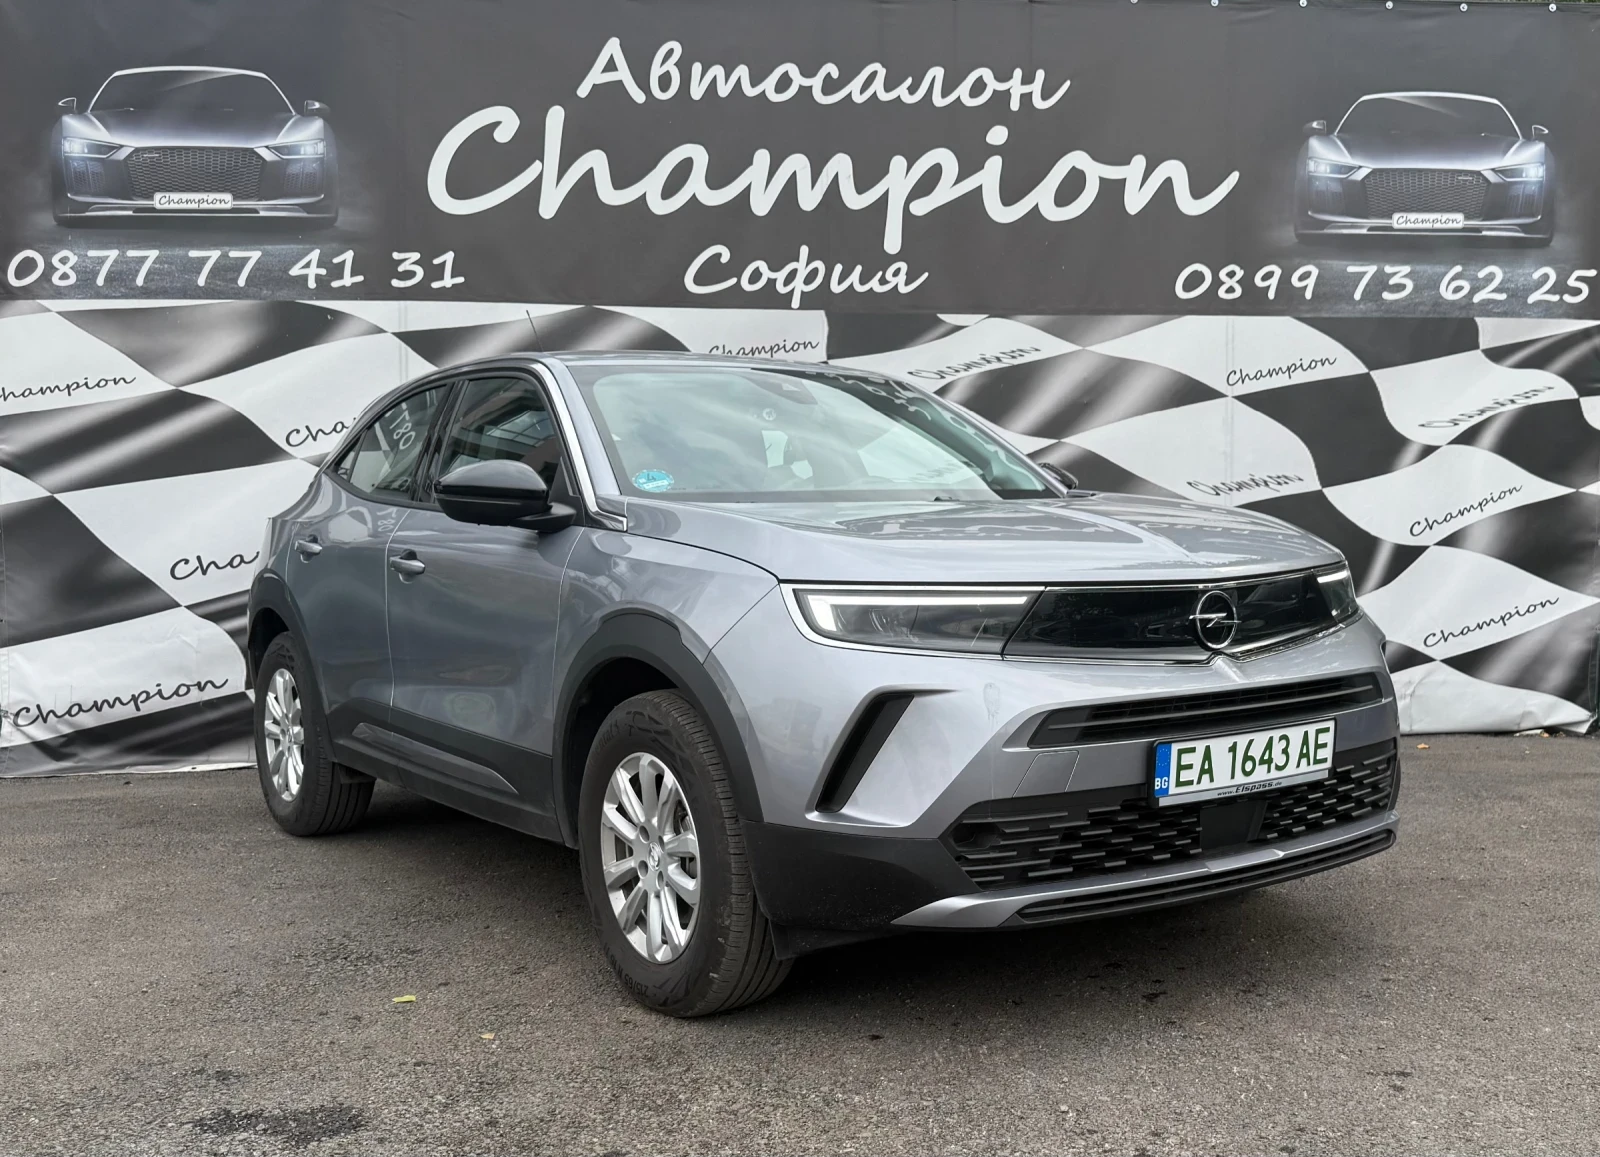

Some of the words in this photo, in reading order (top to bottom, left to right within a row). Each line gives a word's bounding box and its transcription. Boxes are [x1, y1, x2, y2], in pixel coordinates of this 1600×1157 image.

[576, 37, 1071, 111] Автосалон
[427, 105, 1240, 254] Champion
[158, 194, 230, 209] Champion
[1396, 214, 1462, 229] Champion
[7, 249, 160, 287] 0877
[187, 249, 263, 288] 77
[288, 249, 365, 289] 41
[391, 251, 465, 289] 31
[684, 244, 928, 309] София
[1175, 263, 1319, 301] 0899
[1346, 265, 1415, 301] 73
[1439, 265, 1508, 303] 62
[1526, 267, 1599, 304] 25
[0, 376, 137, 402] hampion
[1226, 357, 1338, 387] Champion
[1409, 484, 1523, 538] Champion
[169, 551, 260, 581] Cha
[1423, 596, 1560, 649] Champion
[12, 678, 229, 727] Champion
[1175, 745, 1215, 788] EA
[1228, 733, 1291, 780] 1643
[1296, 727, 1331, 769] AE
[1154, 777, 1169, 790] BG
